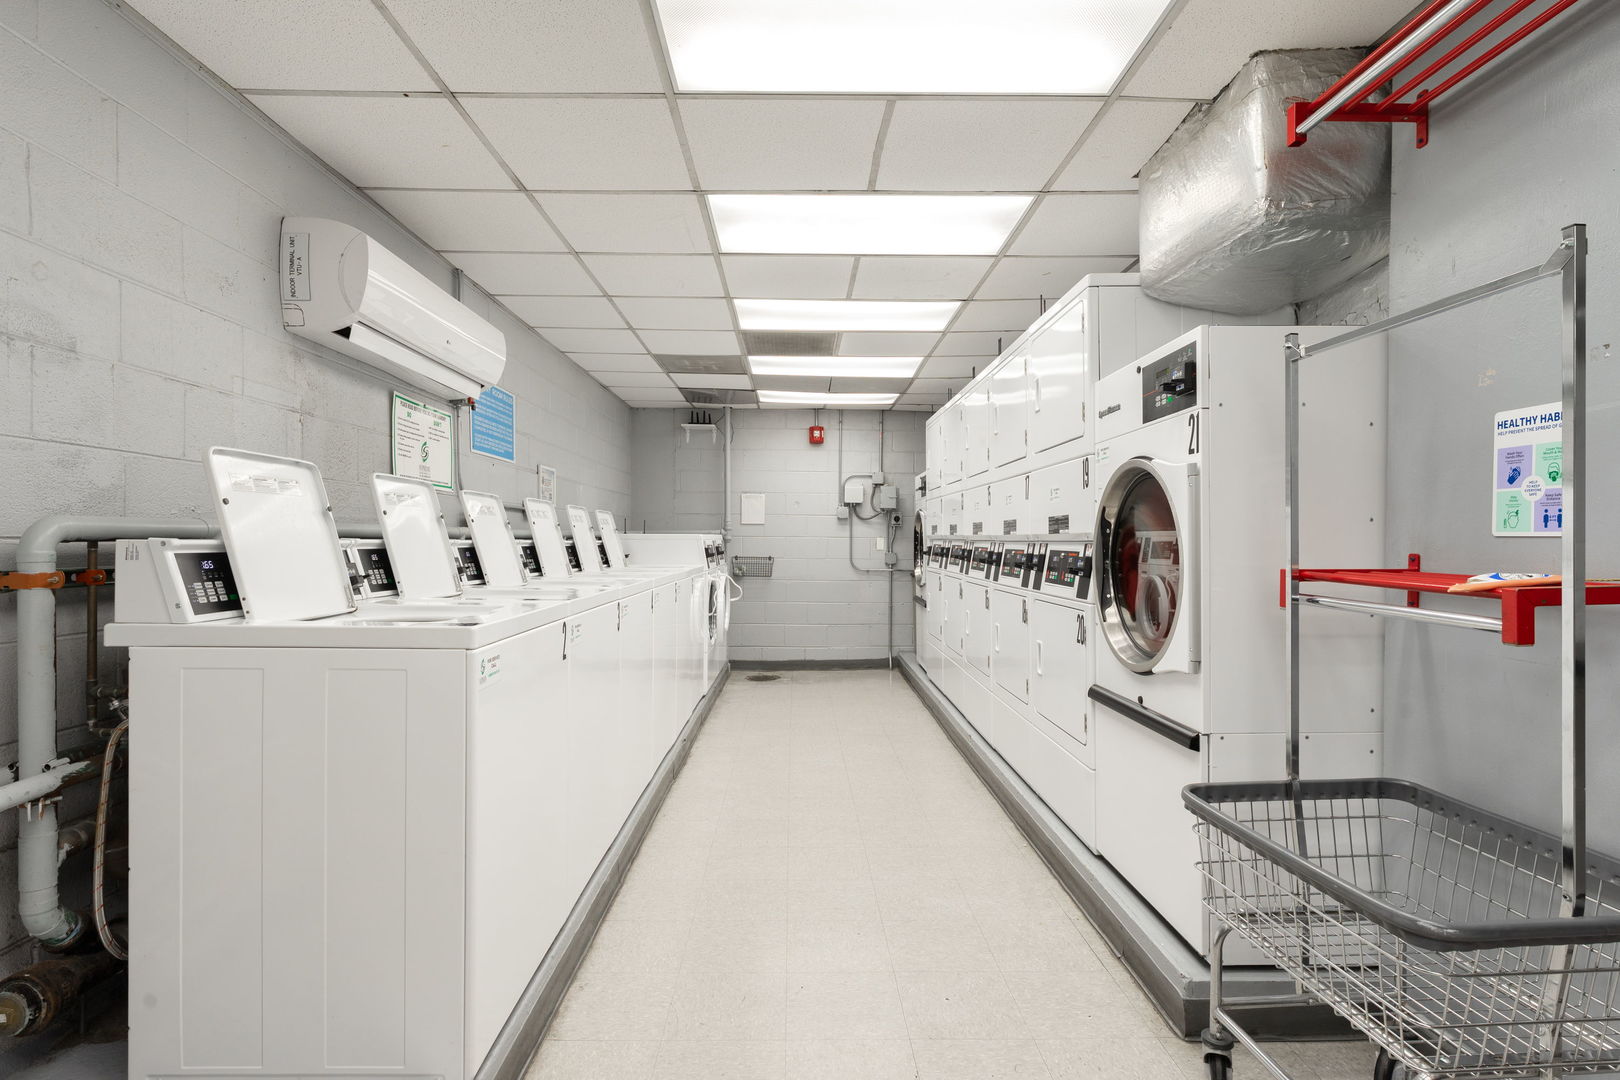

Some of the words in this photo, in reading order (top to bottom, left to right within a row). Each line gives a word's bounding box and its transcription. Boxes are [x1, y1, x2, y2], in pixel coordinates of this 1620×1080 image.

[1188, 411, 1200, 455] 21
[1497, 415, 1538, 430] HEALTHY
[1082, 456, 1090, 489] 19
[562, 621, 567, 661] 2
[1076, 613, 1085, 645] 20
